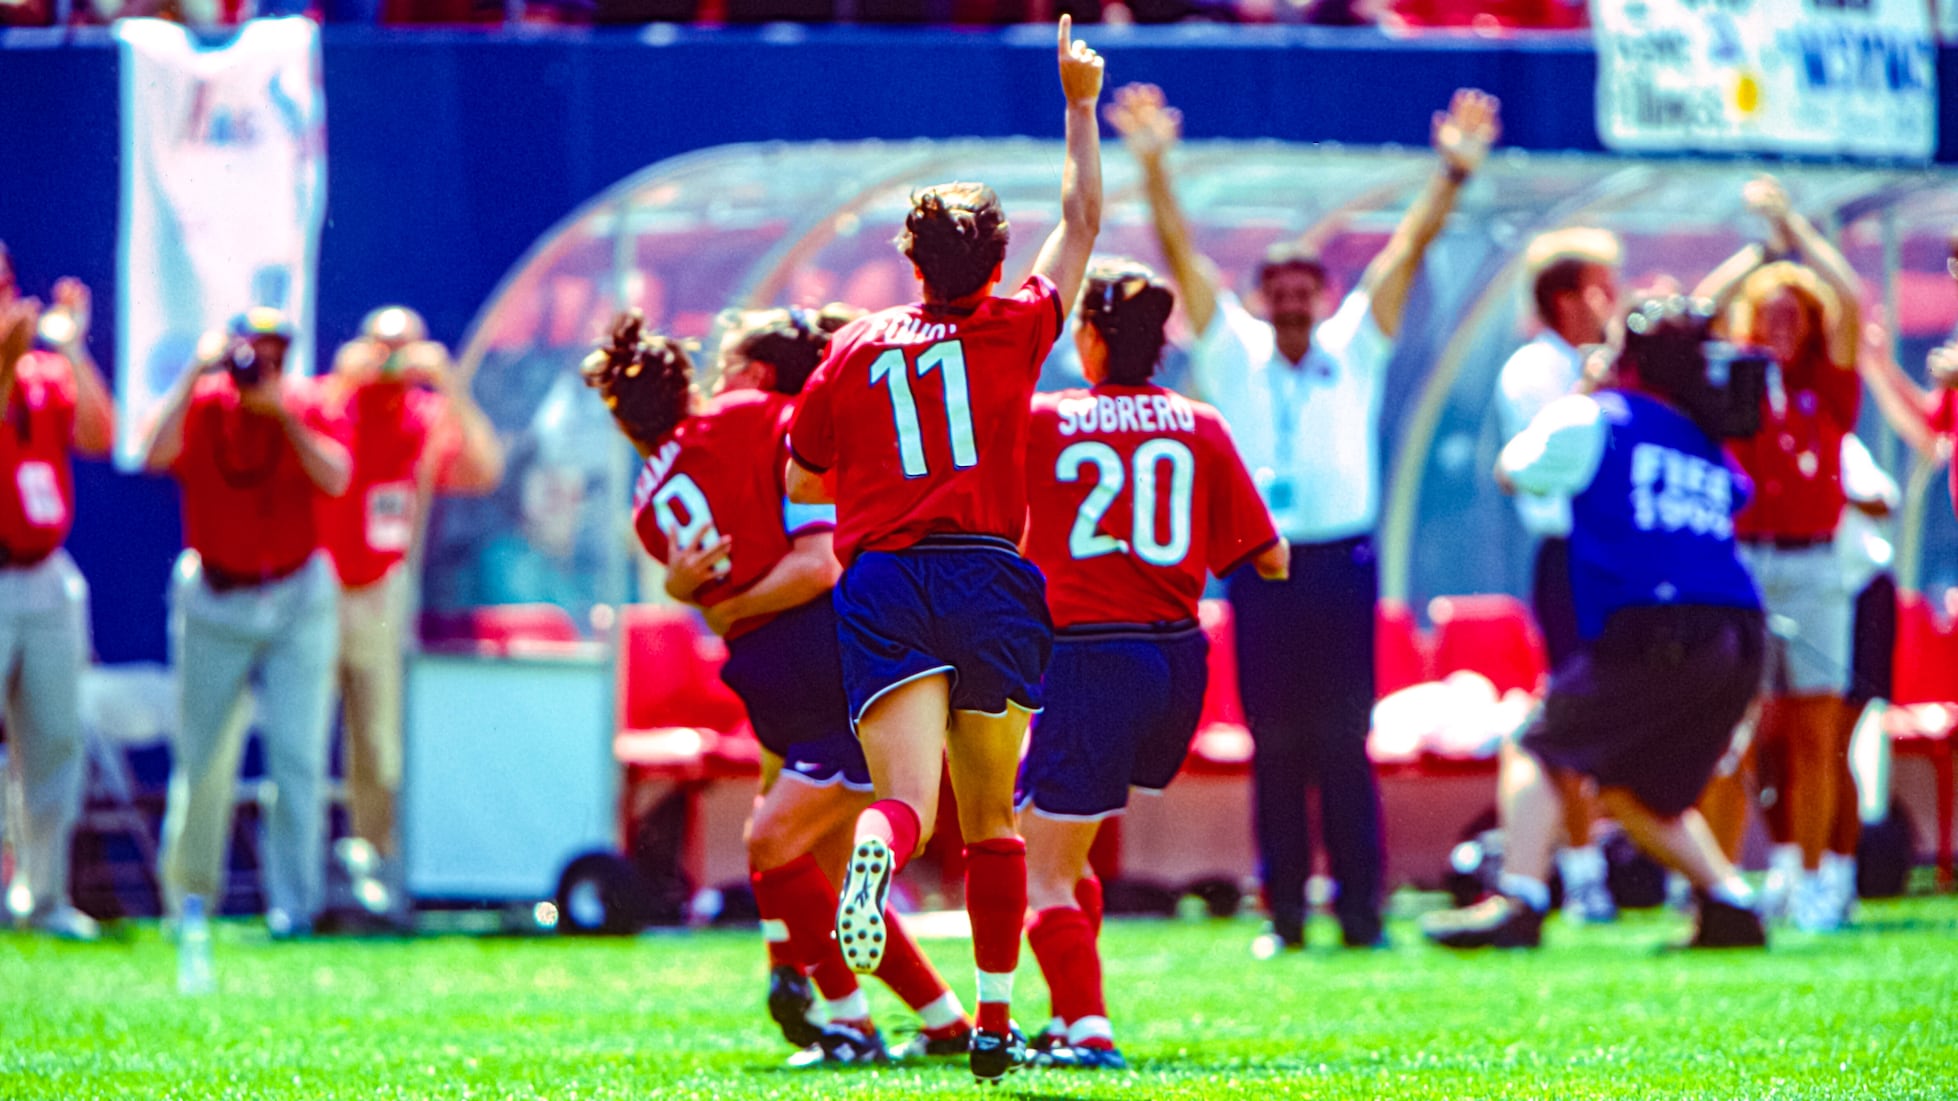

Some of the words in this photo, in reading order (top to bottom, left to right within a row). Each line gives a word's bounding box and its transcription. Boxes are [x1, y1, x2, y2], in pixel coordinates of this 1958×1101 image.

[868, 338, 978, 480] 11
[1056, 394, 1196, 436] SOBRERO
[1055, 437, 1195, 567] 20
